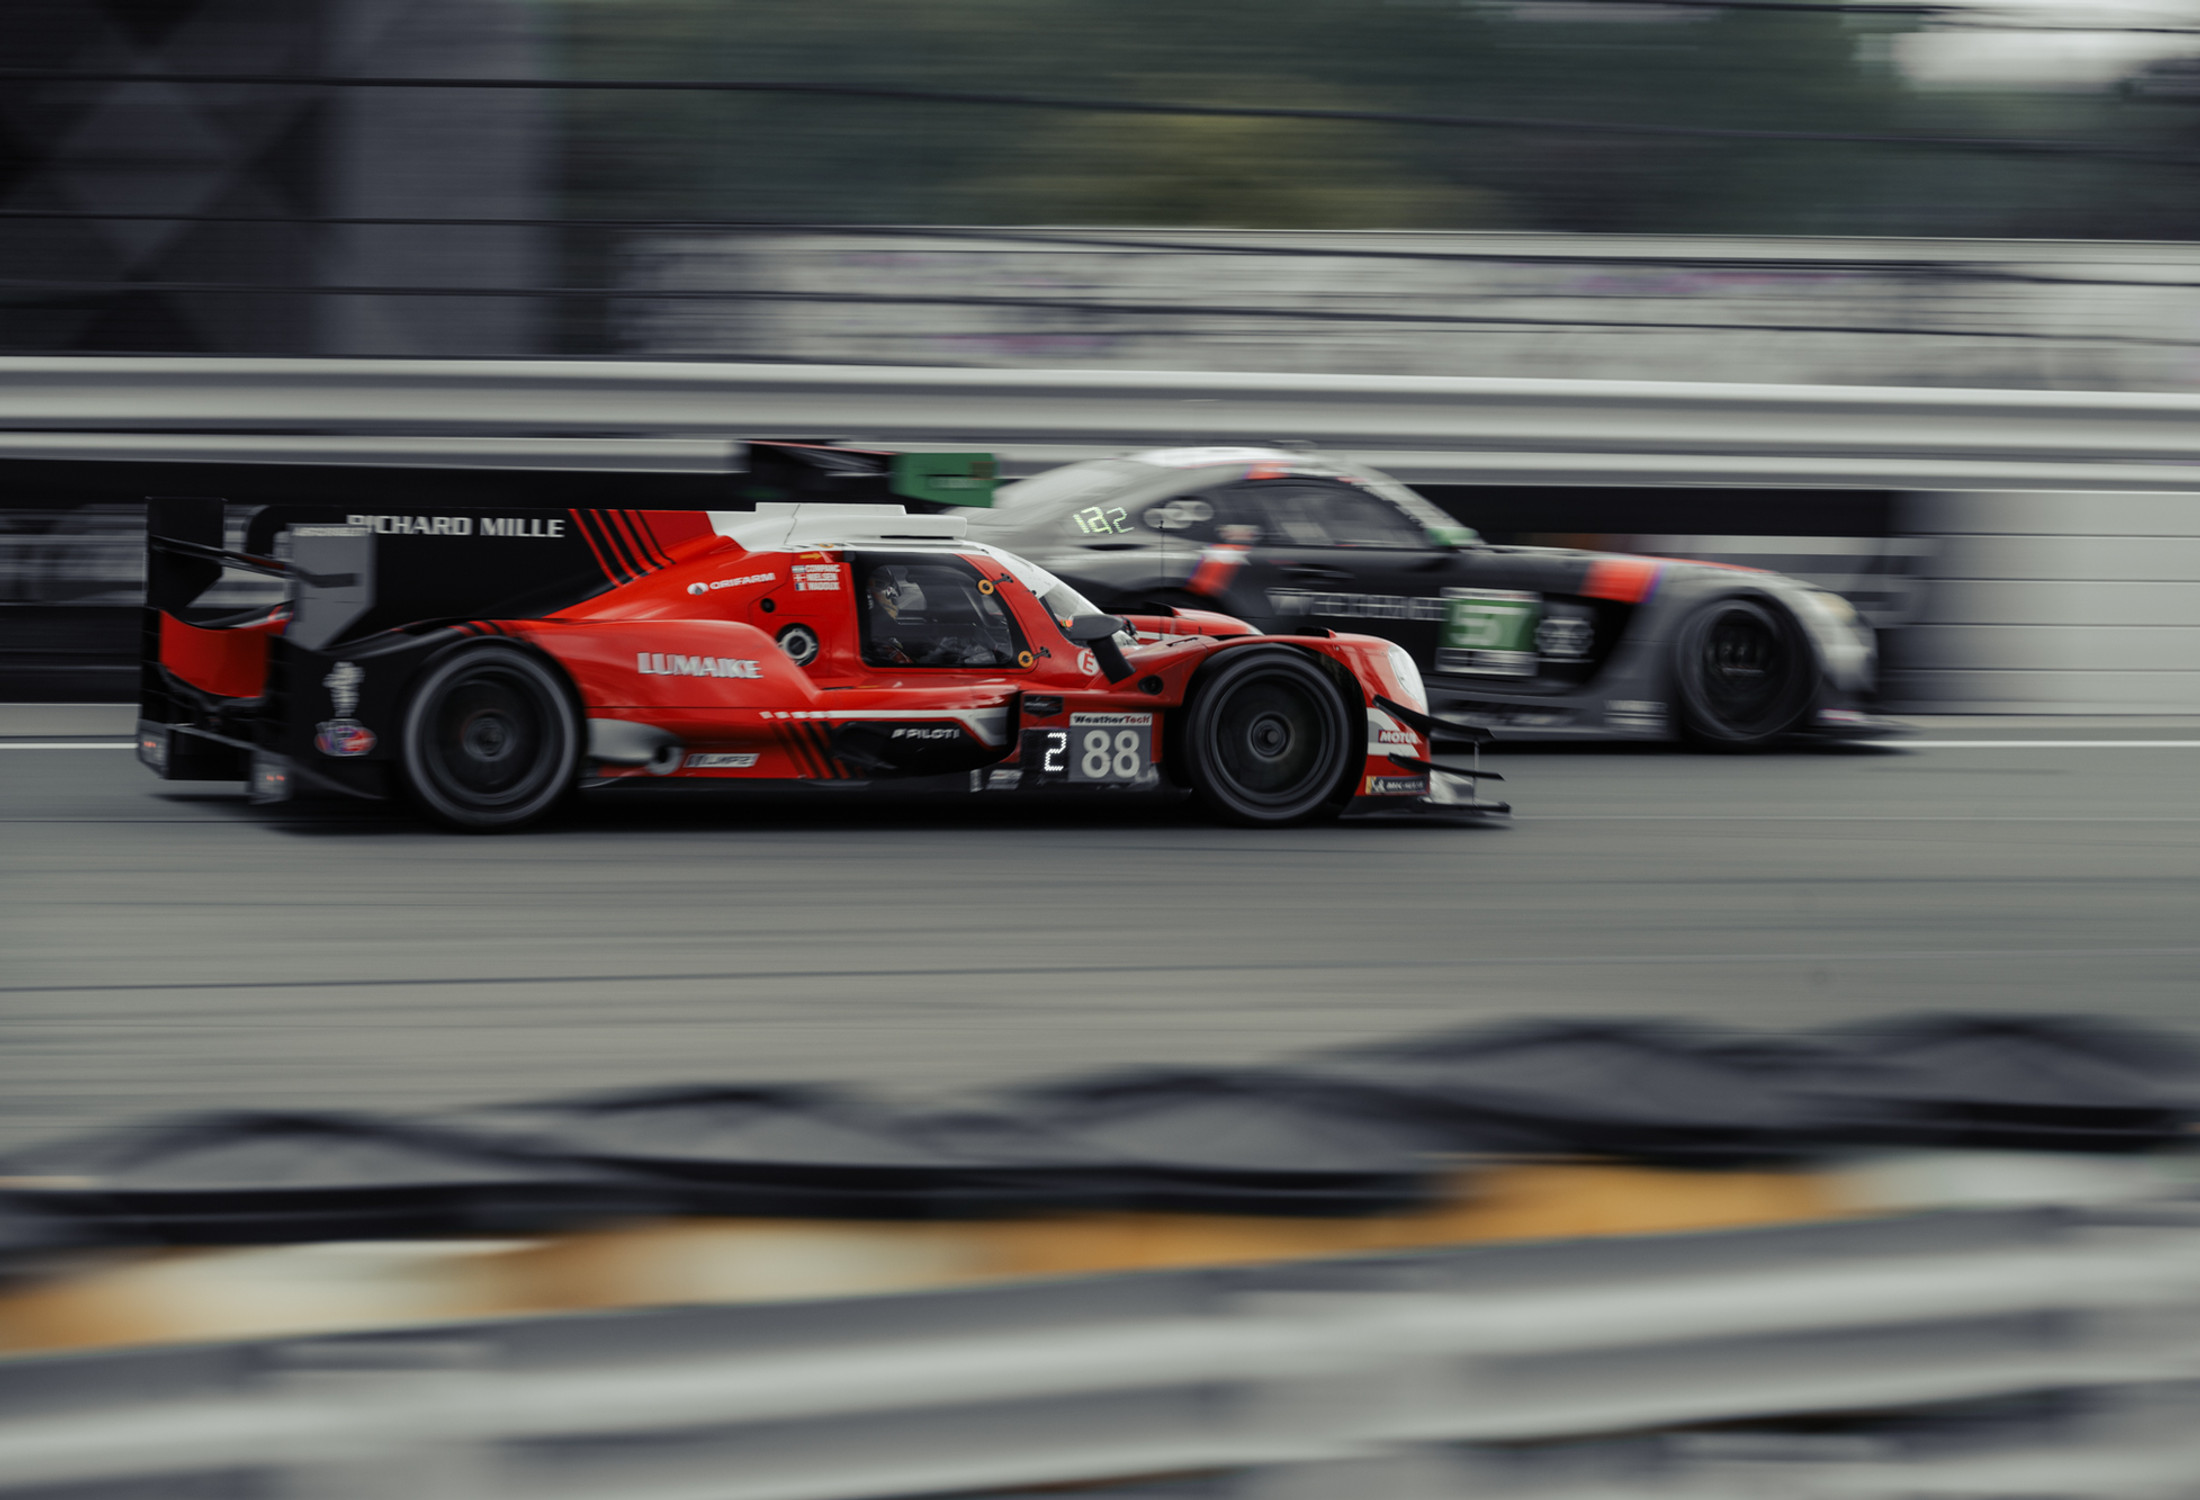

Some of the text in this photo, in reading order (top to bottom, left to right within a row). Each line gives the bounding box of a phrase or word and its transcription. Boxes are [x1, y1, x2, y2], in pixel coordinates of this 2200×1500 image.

[480, 517, 565, 538] MILLE
[709, 572, 776, 590] ORIFARM
[1448, 603, 1532, 648] 57
[1073, 715, 1150, 724] WeatherTech
[905, 728, 960, 740] PILOTI
[1044, 732, 1067, 772] 2
[1081, 729, 1141, 778] 88
